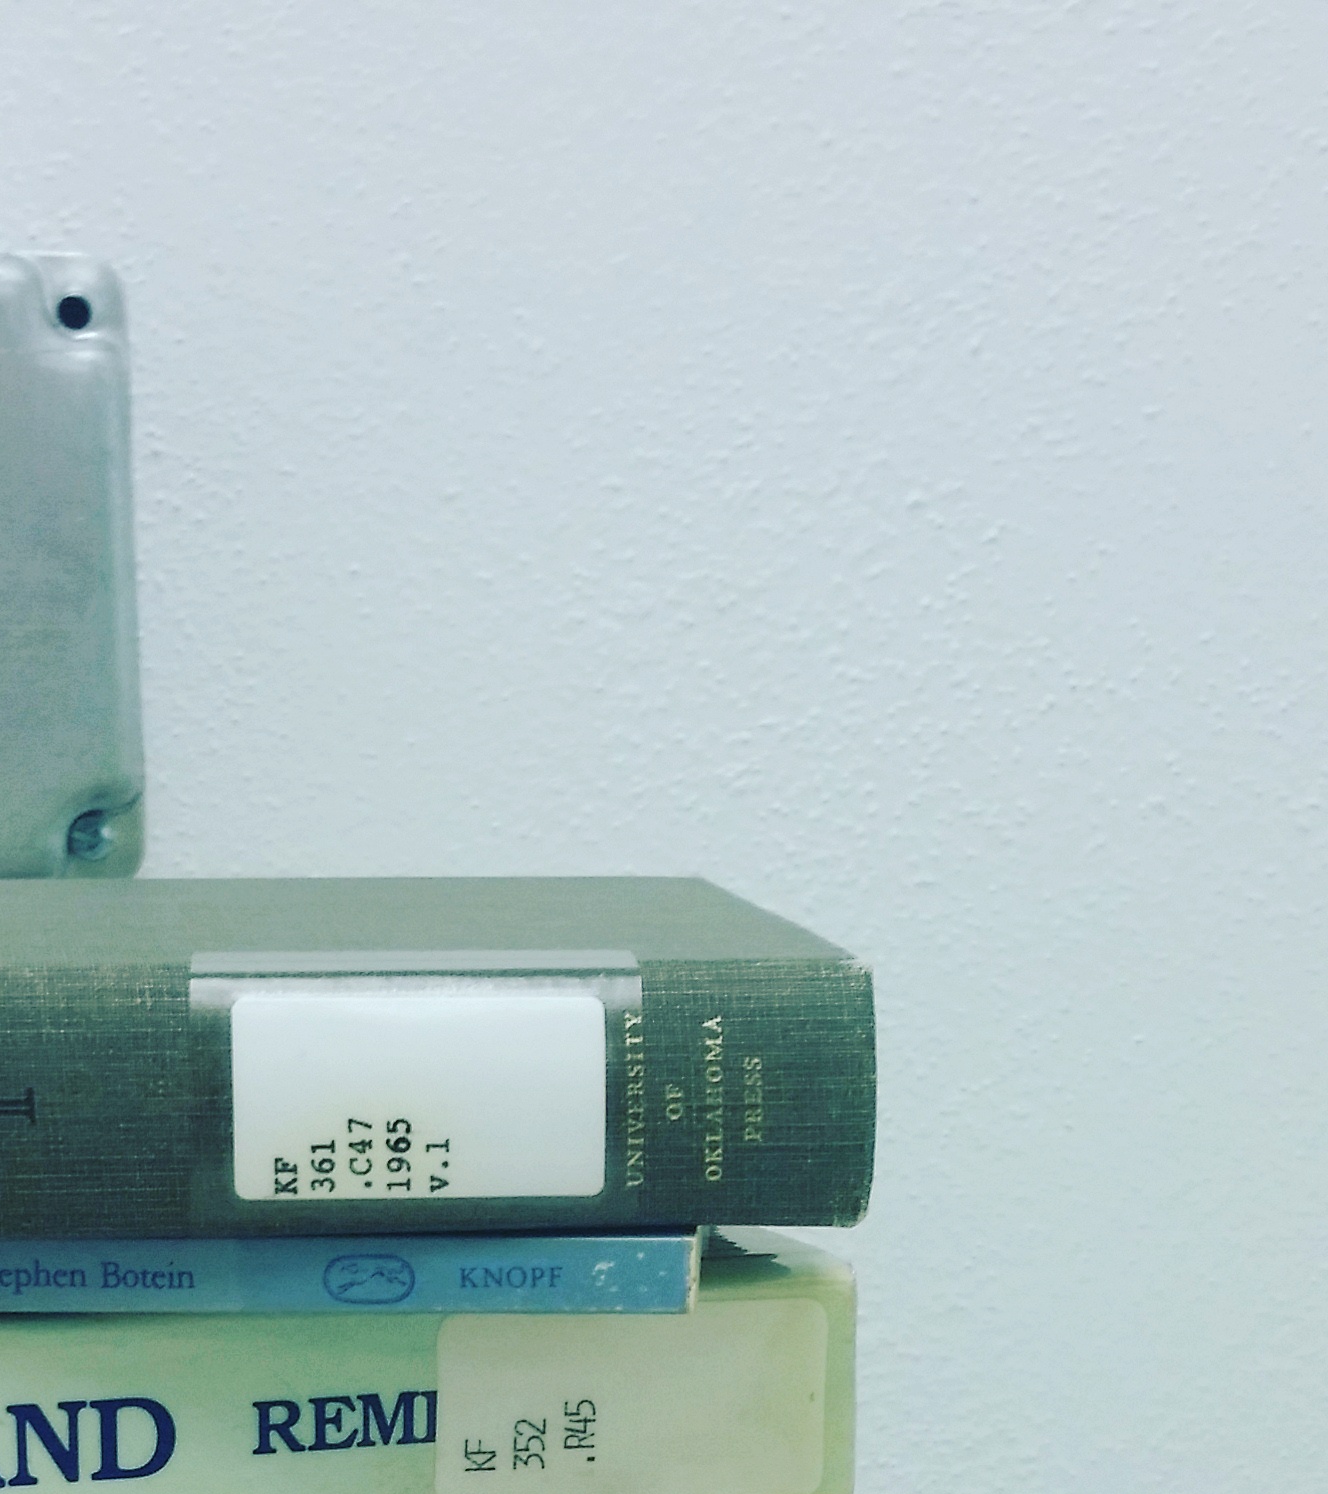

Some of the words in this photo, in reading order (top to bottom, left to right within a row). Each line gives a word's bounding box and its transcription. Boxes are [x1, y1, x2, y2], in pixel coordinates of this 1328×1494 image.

[625, 1011, 644, 1189] UNIVERSITY
[666, 1084, 684, 1122] OF
[705, 1013, 723, 1182] OKLAHOMA
[745, 1056, 763, 1143] PRESS
[274, 1157, 299, 1196] KF
[310, 1139, 336, 1193] 361
[349, 1117, 373, 1190] .C47
[386, 1117, 412, 1193] 1965
[429, 1137, 451, 1194] v.1
[100, 1261, 196, 1291] Botein
[459, 1266, 563, 1290] KNOPF
[464, 1438, 497, 1473] KF
[513, 1417, 547, 1471] 352
[563, 1398, 597, 1462] .R45
